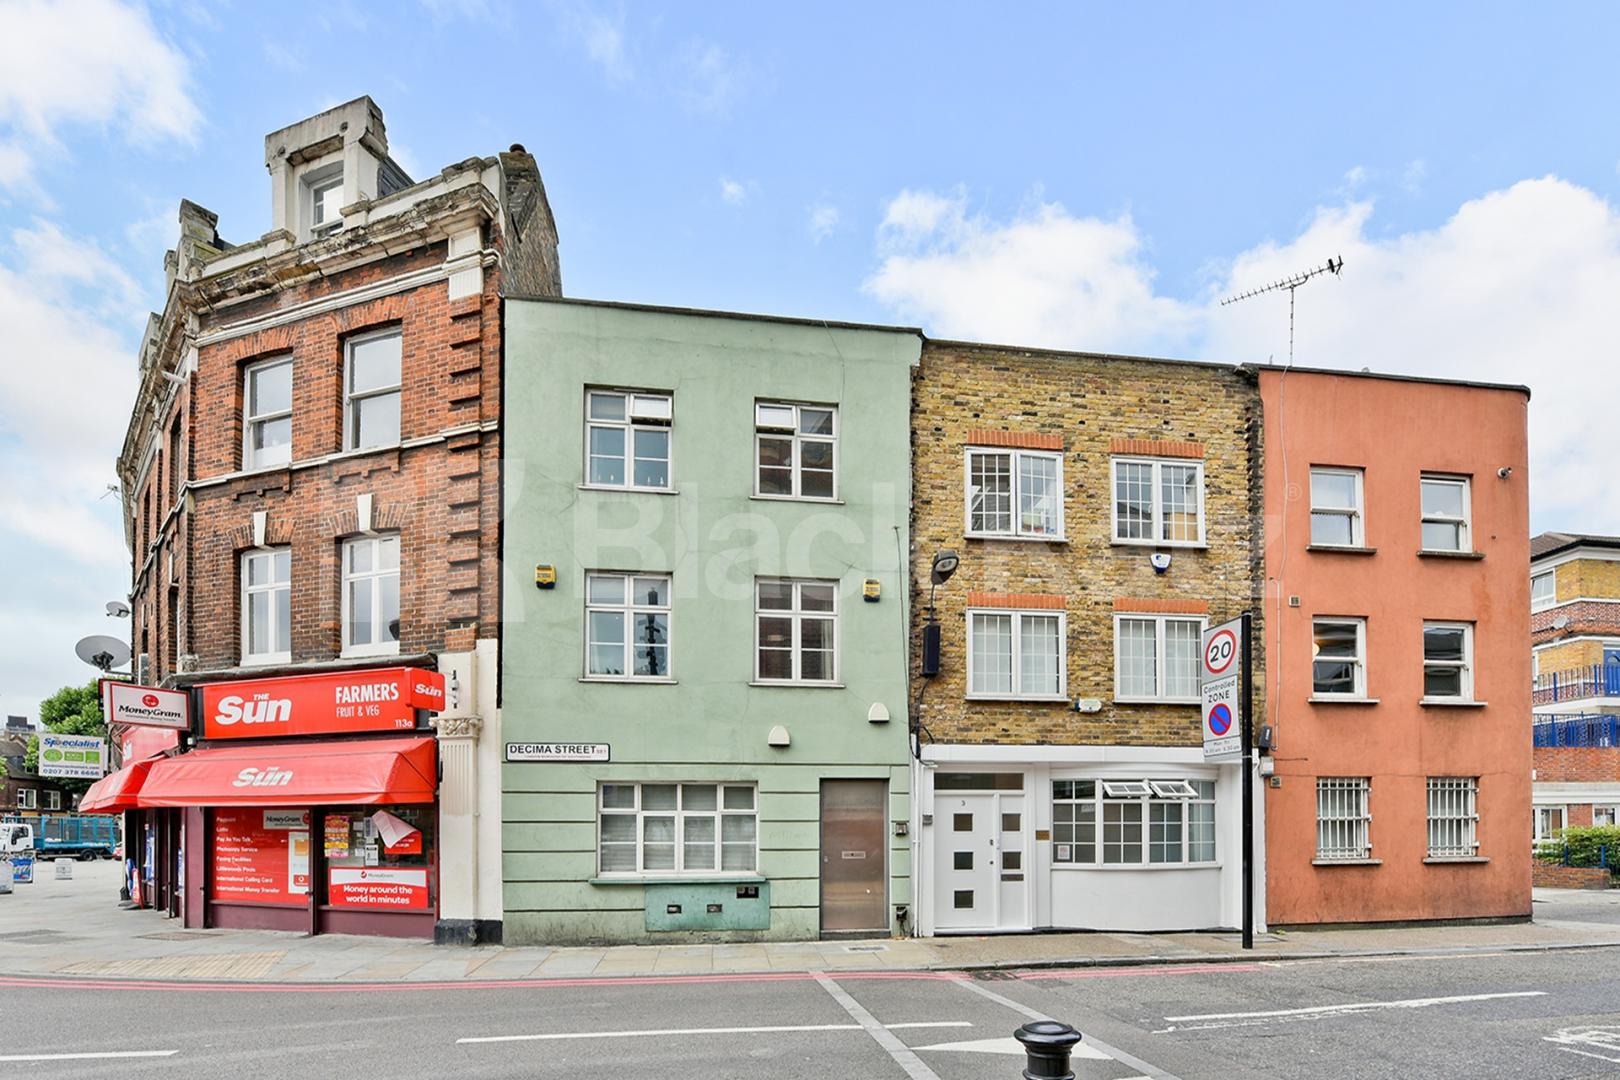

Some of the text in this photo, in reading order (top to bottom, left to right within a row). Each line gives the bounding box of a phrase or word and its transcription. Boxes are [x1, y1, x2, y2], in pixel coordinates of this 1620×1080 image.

[1210, 640, 1231, 662] 20
[335, 682, 399, 704] FARMERS
[415, 683, 442, 697] Sun
[1203, 679, 1235, 694] Controlled
[253, 693, 270, 701] THE
[1208, 690, 1230, 703] ZONE
[118, 704, 181, 719] MoneyGram
[214, 695, 292, 726] Sun
[336, 704, 379, 718] FRUIT & VEG
[395, 719, 413, 728] 113a
[509, 745, 552, 754] DECIMA
[555, 745, 596, 754] STREET
[232, 768, 294, 787] Sun
[343, 884, 413, 895] Money around the
[345, 894, 410, 904] world in minutes
